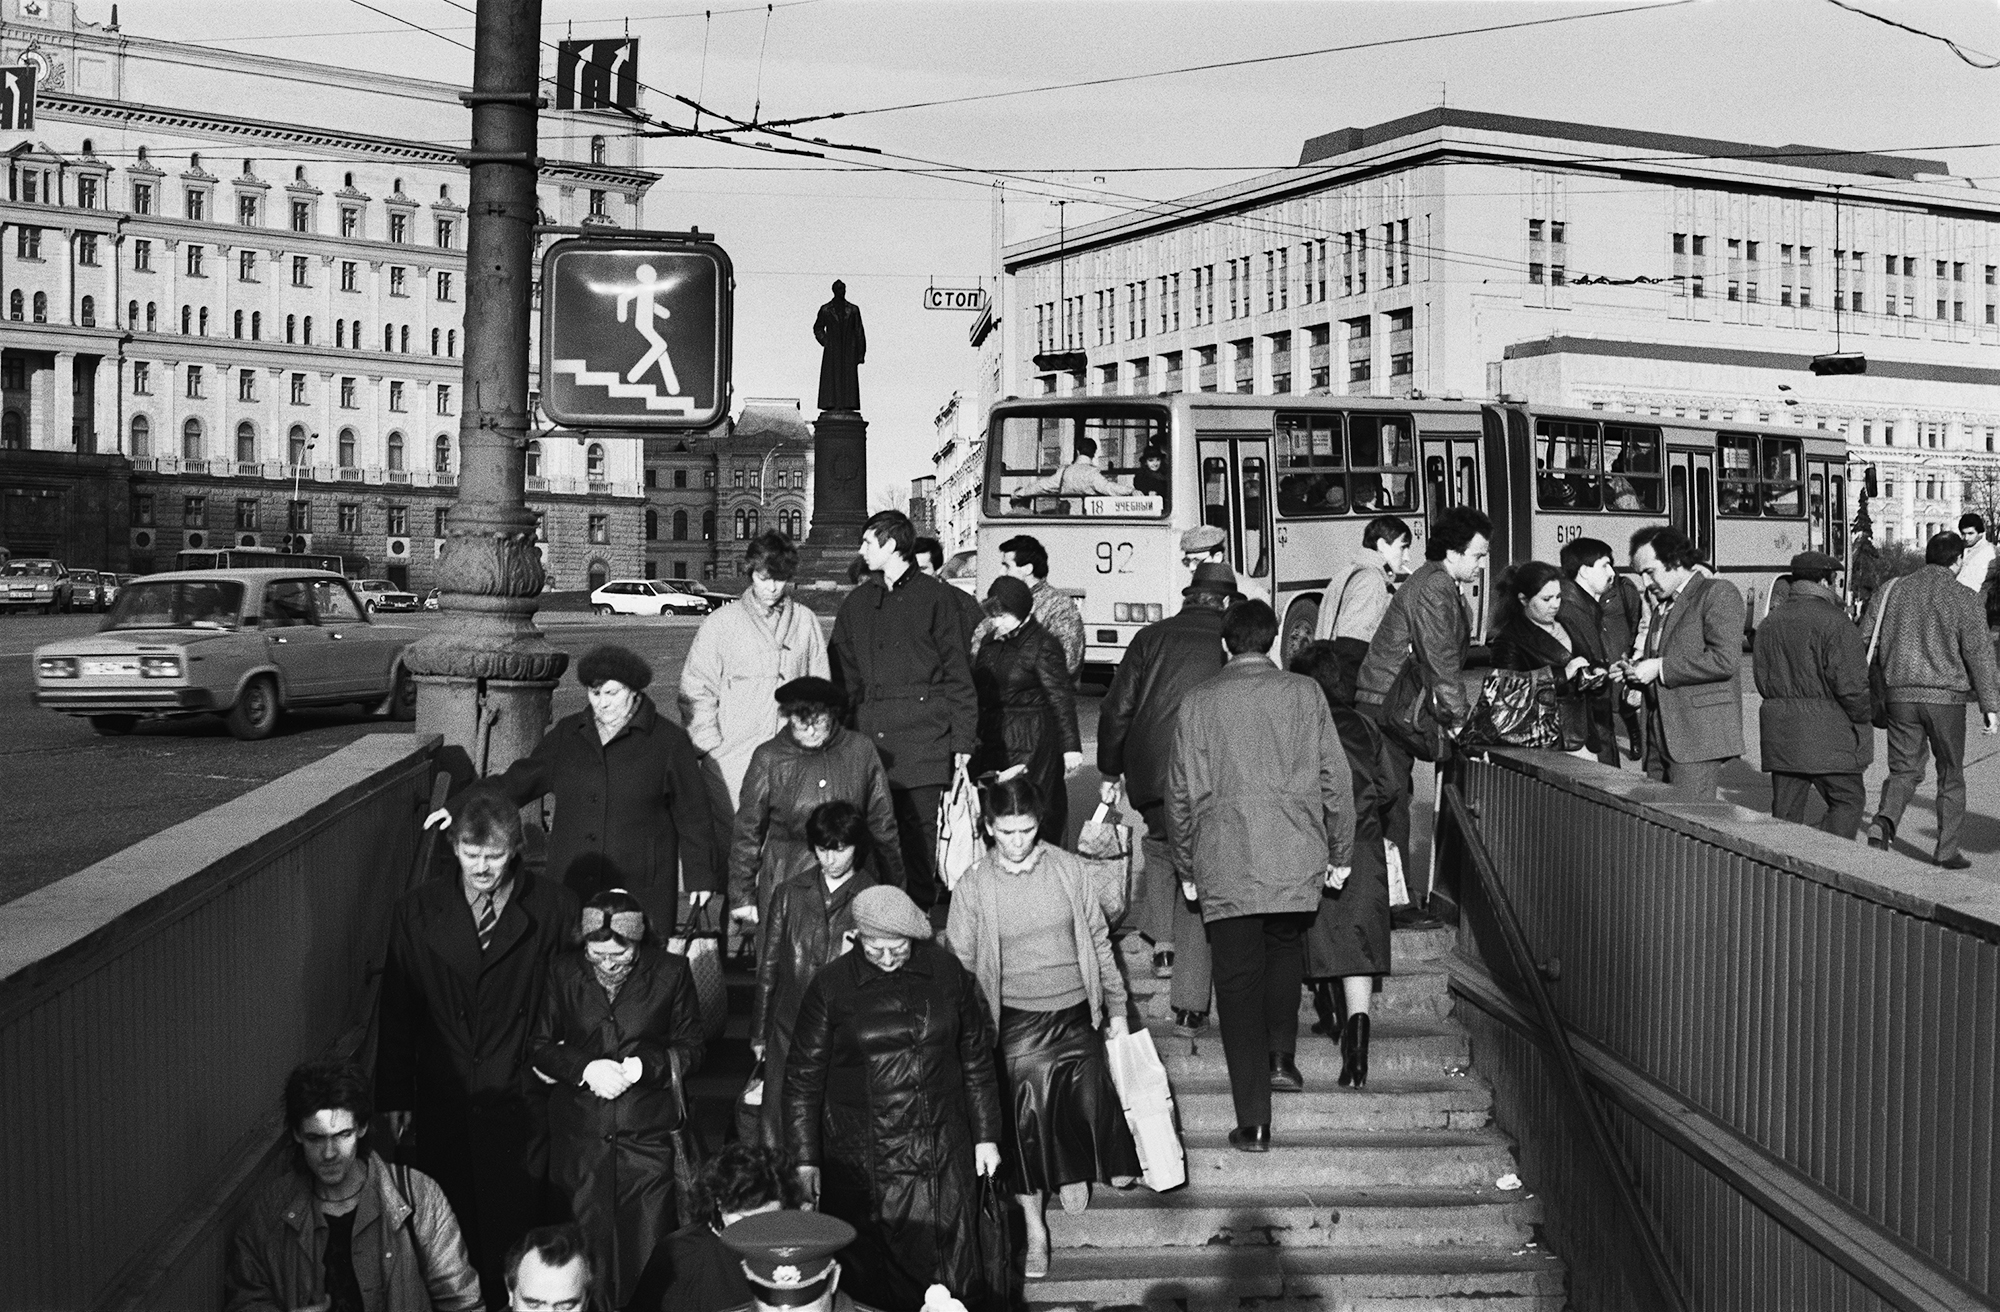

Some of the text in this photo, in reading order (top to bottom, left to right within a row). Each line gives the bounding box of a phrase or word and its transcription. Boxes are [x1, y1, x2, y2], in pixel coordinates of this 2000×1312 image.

[932, 291, 978, 307] СТОП
[1091, 500, 1104, 514] 18
[1096, 541, 1134, 574] 92
